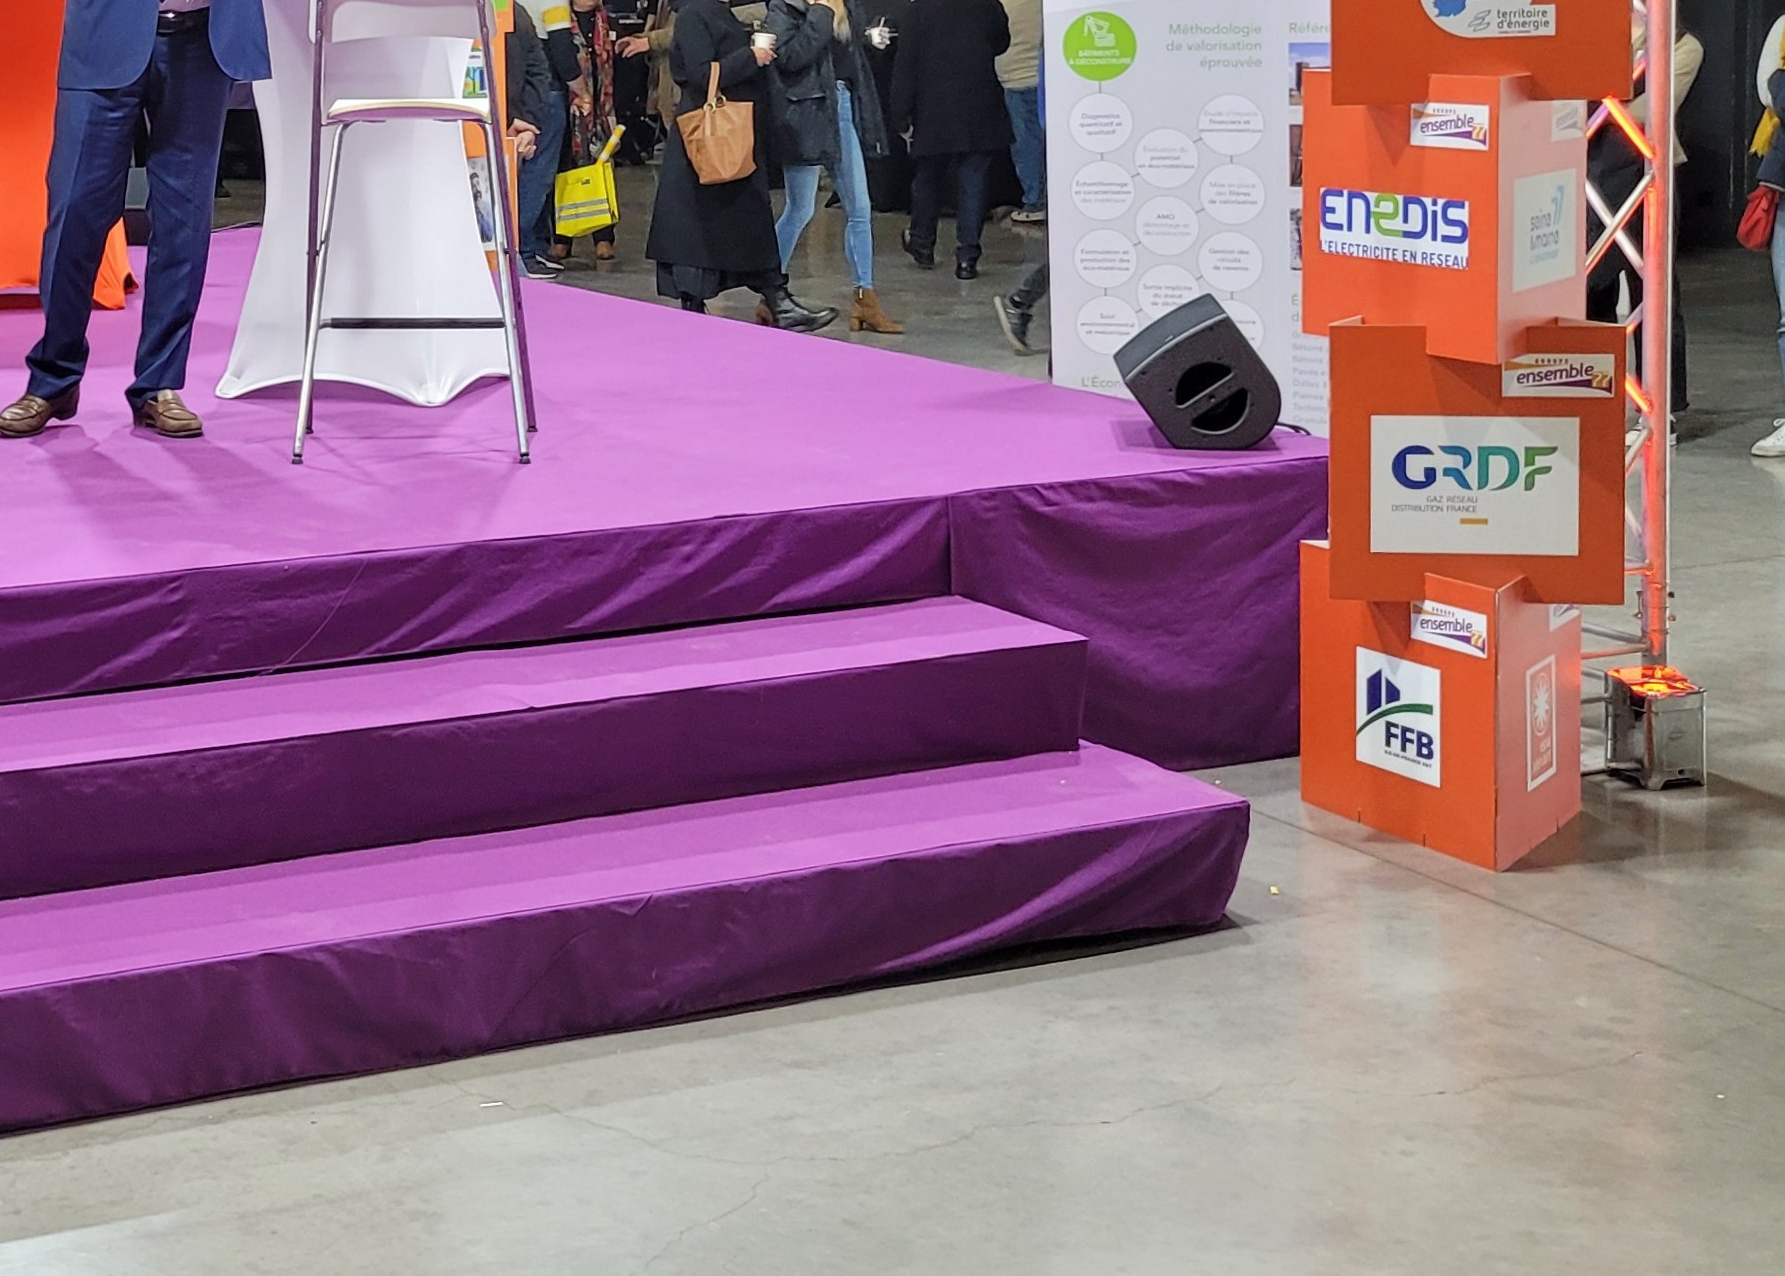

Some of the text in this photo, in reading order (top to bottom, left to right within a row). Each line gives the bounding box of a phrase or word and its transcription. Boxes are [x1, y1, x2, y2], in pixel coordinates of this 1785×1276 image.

[1497, 9, 1548, 20] territoire
[1168, 23, 1262, 38] Méthodologie
[1497, 19, 1550, 31] d'énergie
[1166, 39, 1262, 52] de valorisation
[1200, 56, 1262, 71] éprouvée
[1420, 113, 1475, 133] ensemble
[1402, 250, 1418, 263] EN
[1516, 362, 1594, 384] ensemble
[1392, 445, 1558, 491] GRDF
[1392, 505, 1477, 513] DISTRIBUTION FRANCE
[1420, 617, 1473, 633] ensemble
[1385, 720, 1433, 760] FFB
